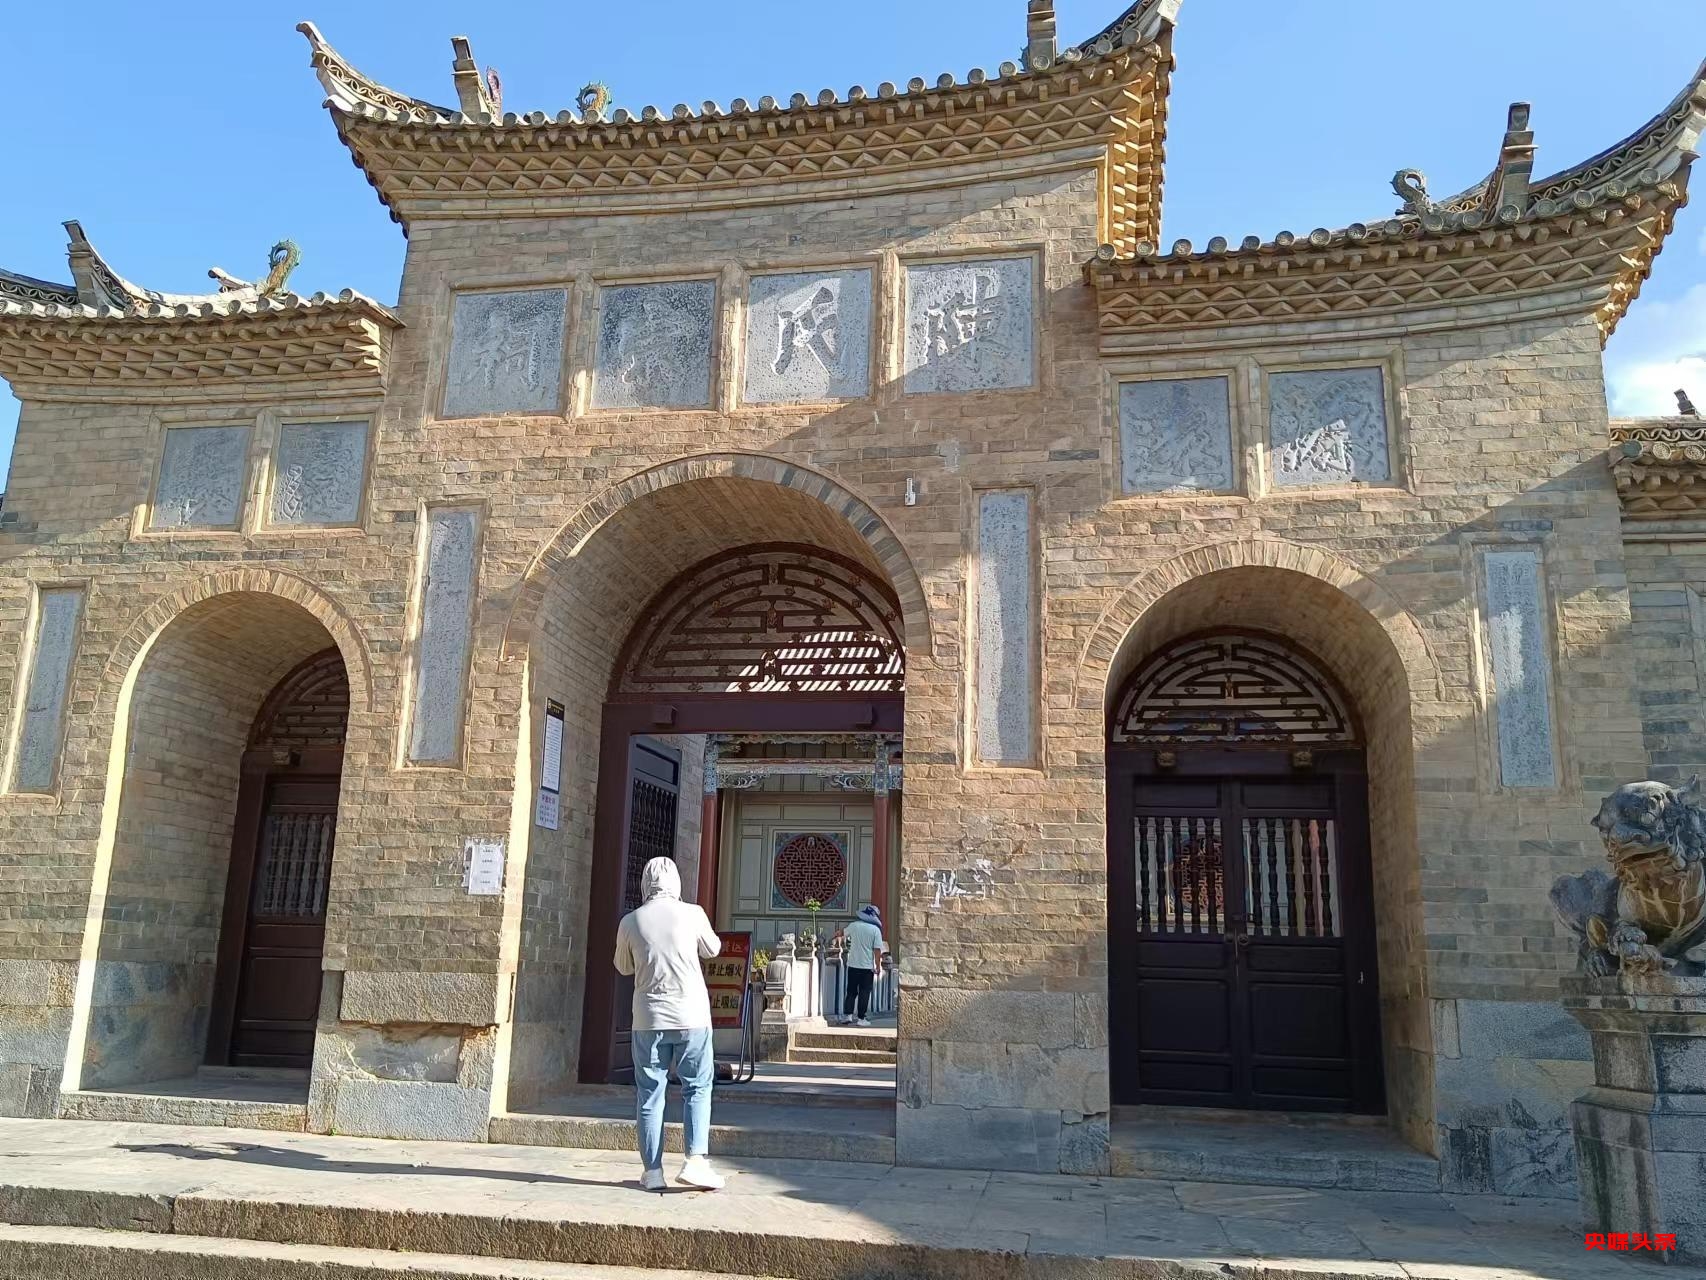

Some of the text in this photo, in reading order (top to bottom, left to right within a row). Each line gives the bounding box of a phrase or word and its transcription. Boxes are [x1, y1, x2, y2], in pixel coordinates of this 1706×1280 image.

[708, 963, 743, 978] 禁止烟火
[710, 994, 740, 1009] 止吸烟
